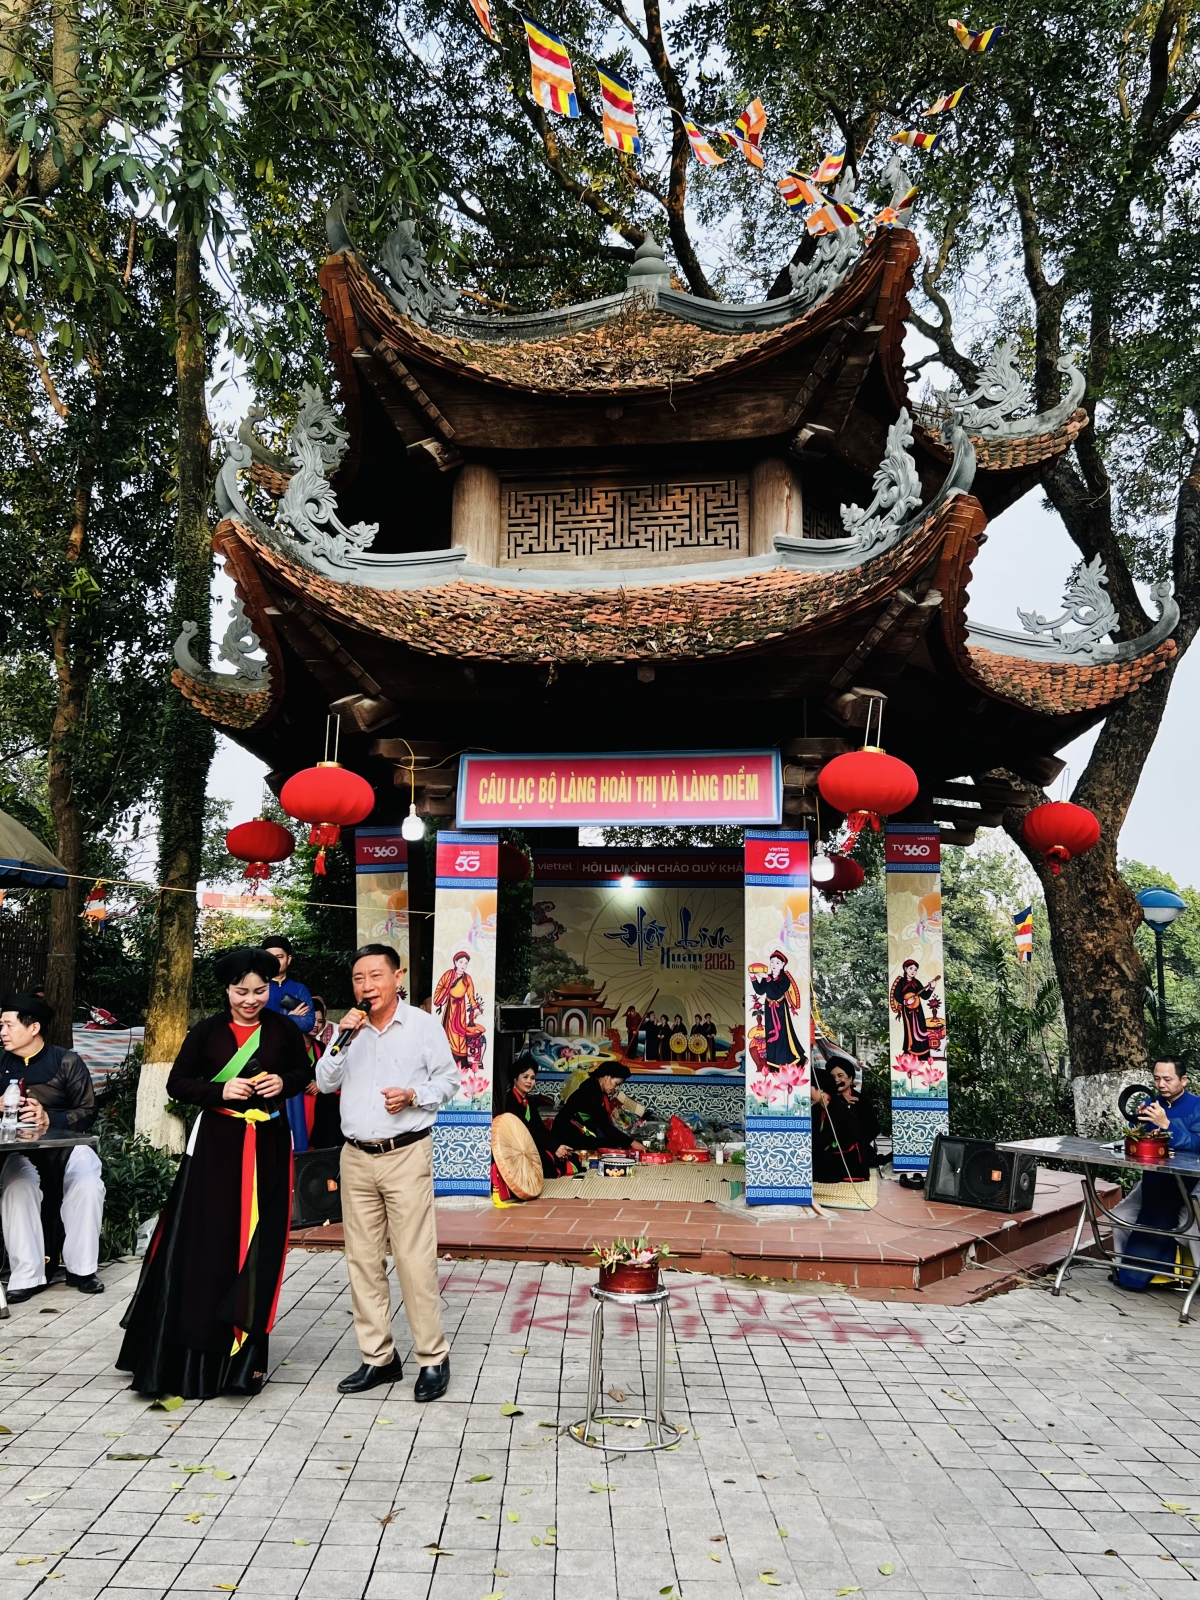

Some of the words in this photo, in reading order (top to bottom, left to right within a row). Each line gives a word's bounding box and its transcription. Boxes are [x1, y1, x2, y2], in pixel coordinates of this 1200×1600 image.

[478, 772, 506, 804] CÂU
[509, 777, 535, 810] LẠC
[538, 771, 557, 810] BỘ
[560, 771, 596, 803] LÀNG
[600, 771, 632, 803] HOÀI
[636, 775, 657, 809] THỊ
[661, 769, 679, 802] VÀ
[682, 769, 719, 802] LÀNG
[362, 846, 398, 857] TV360
[891, 844, 931, 857] TV360
[454, 855, 480, 872] 5G
[537, 862, 573, 871] viettel
[582, 861, 602, 874] HỘI
[604, 863, 625, 873] LIM
[627, 861, 655, 873] KÍNH
[657, 861, 690, 873] CHÀO
[691, 861, 717, 873] QUÝ
[764, 852, 790, 869] 5G
[674, 906, 734, 949] Lim
[704, 952, 736, 971] 2026
